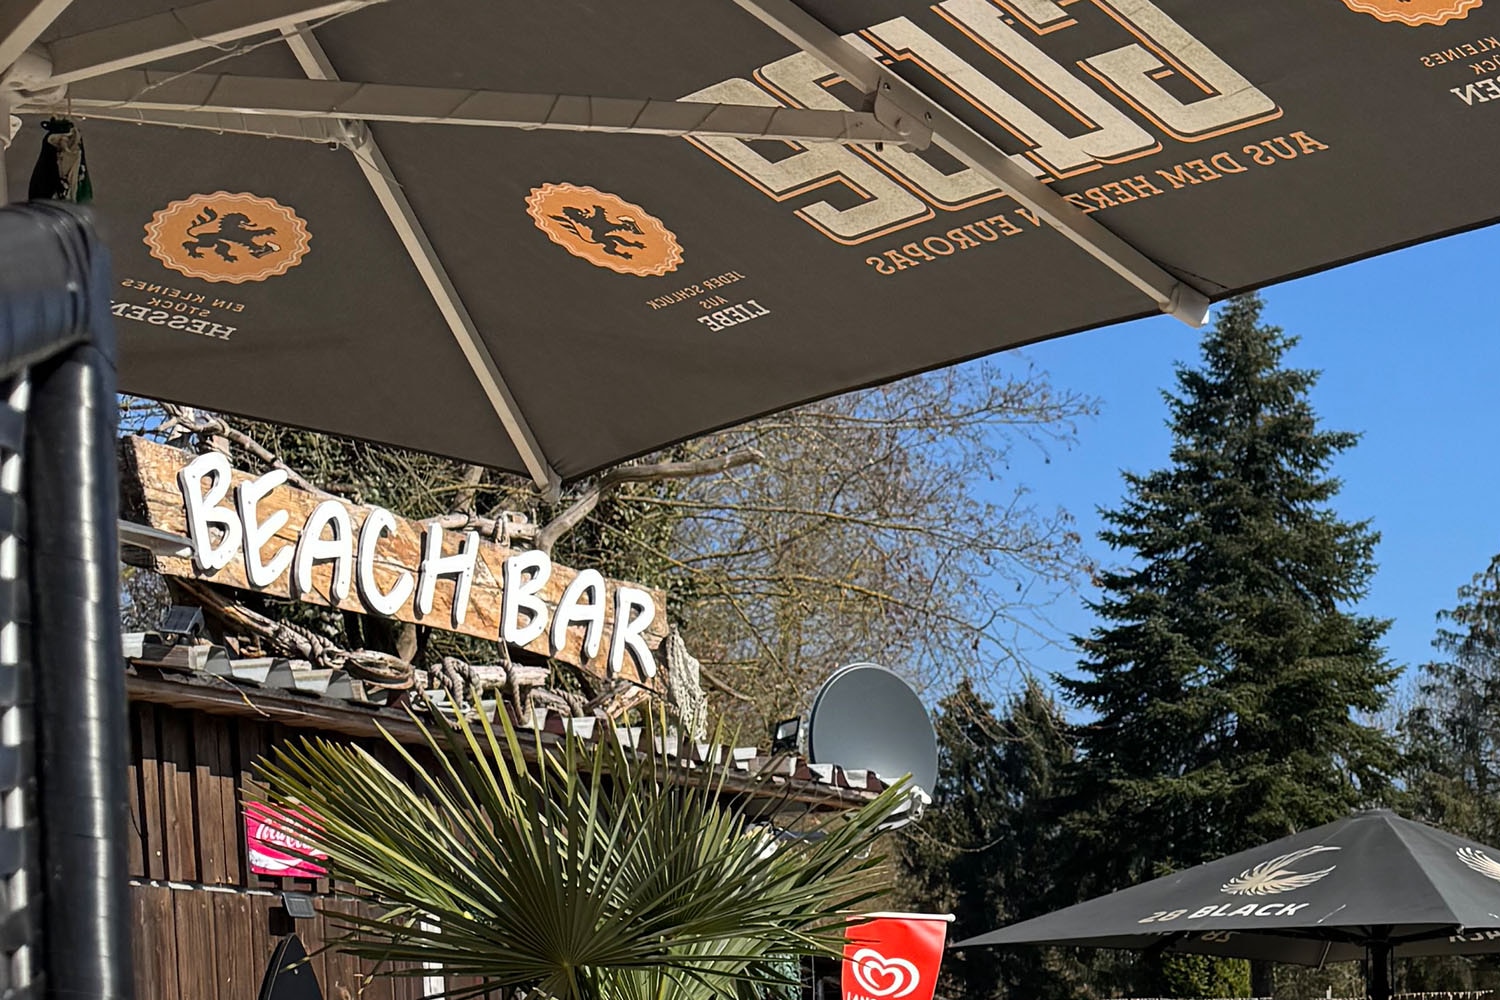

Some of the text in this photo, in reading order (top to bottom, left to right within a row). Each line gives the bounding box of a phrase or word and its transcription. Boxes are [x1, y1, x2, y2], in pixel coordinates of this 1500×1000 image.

[177, 451, 658, 680] BEACH BAR
[1137, 902, 1310, 924] 28 BLACK
